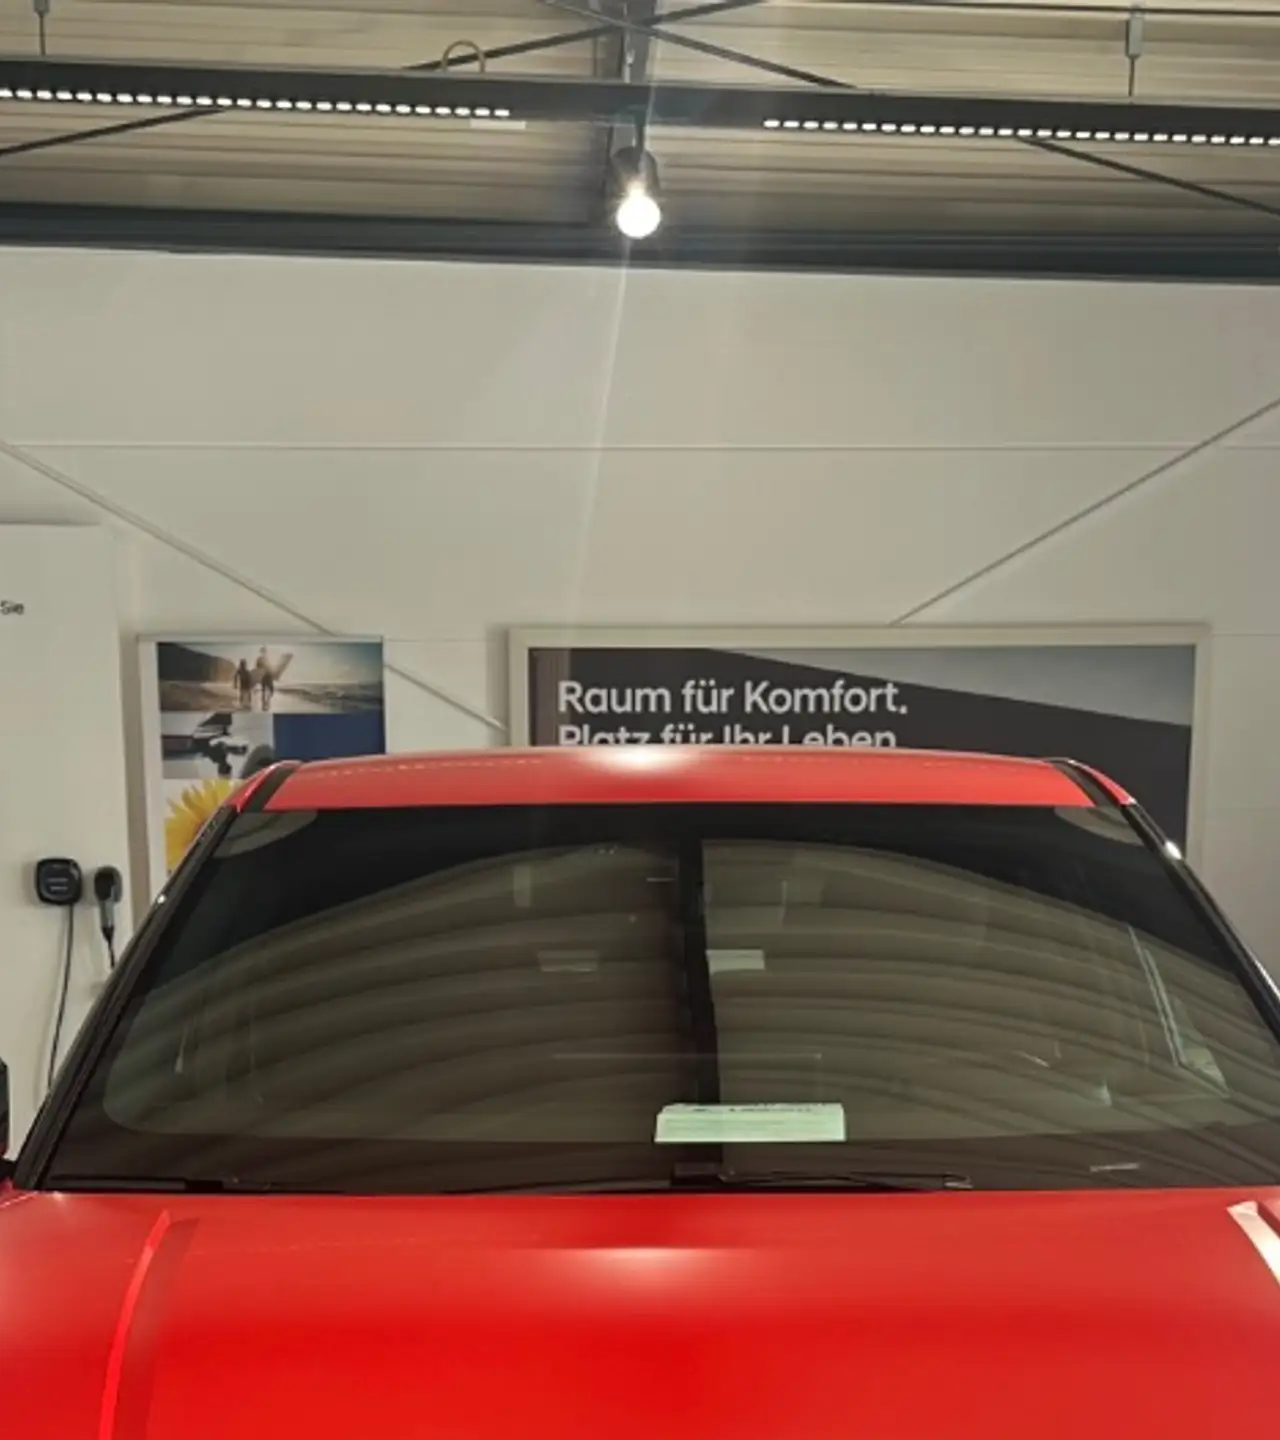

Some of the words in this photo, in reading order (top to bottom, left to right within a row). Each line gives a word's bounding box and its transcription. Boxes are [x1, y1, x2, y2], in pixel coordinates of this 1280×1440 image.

[0, 599, 25, 615] Sie
[558, 680, 672, 713] Raum
[681, 679, 735, 713] für
[743, 679, 909, 714] Komfort.
